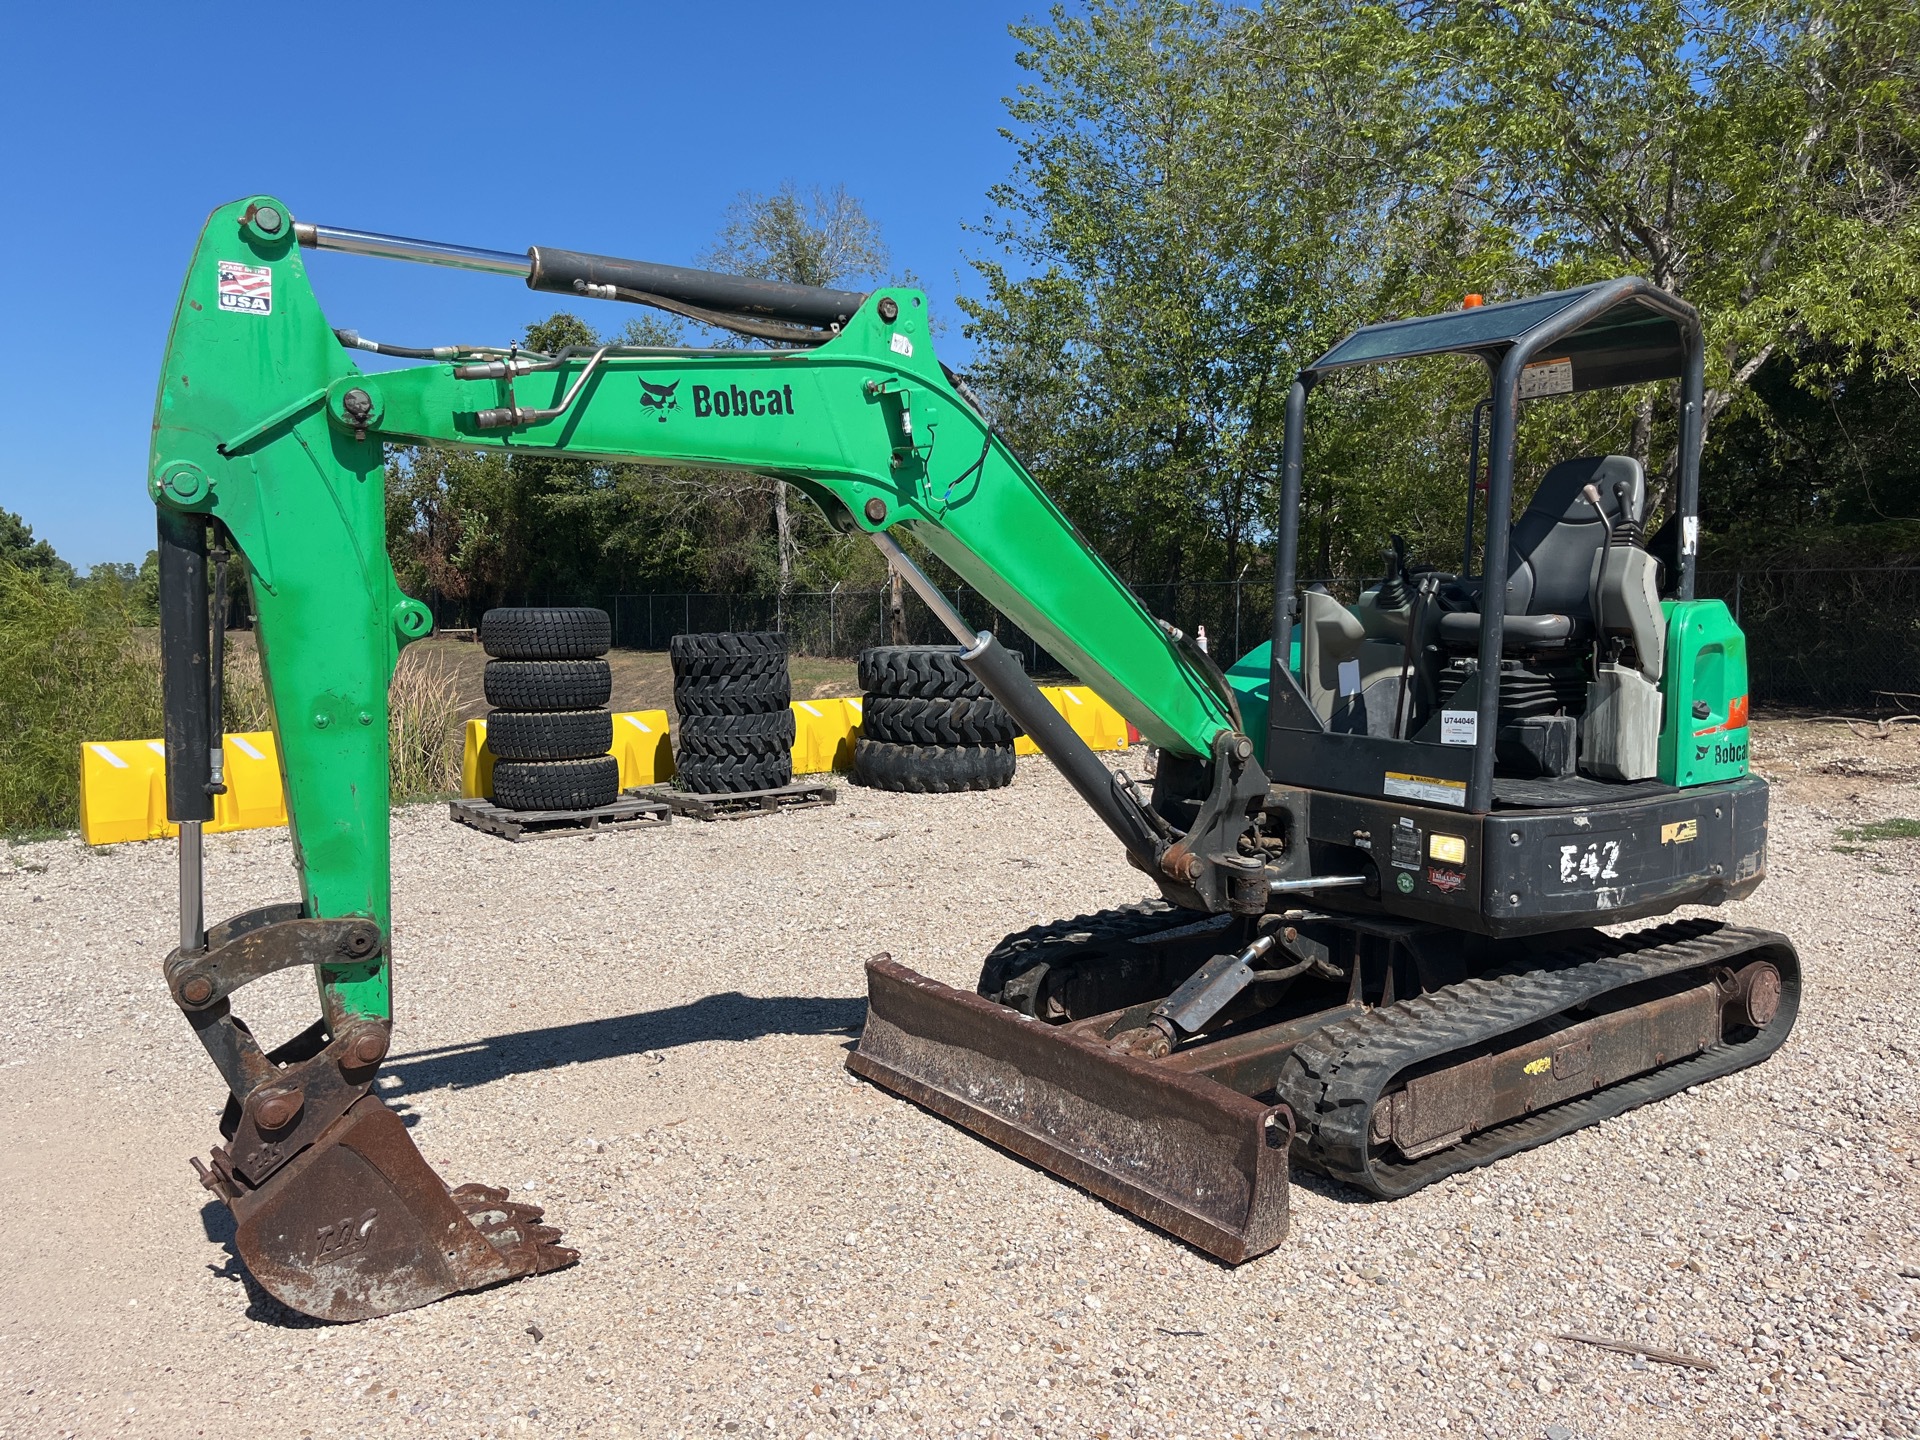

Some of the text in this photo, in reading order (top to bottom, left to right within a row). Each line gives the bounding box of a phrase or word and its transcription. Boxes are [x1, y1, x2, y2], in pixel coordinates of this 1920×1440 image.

[222, 294, 267, 310] USA
[692, 384, 795, 417] Bobcat
[1444, 717, 1475, 725] U744046
[1415, 776, 1441, 785] WARNING
[1560, 840, 1620, 885] E42
